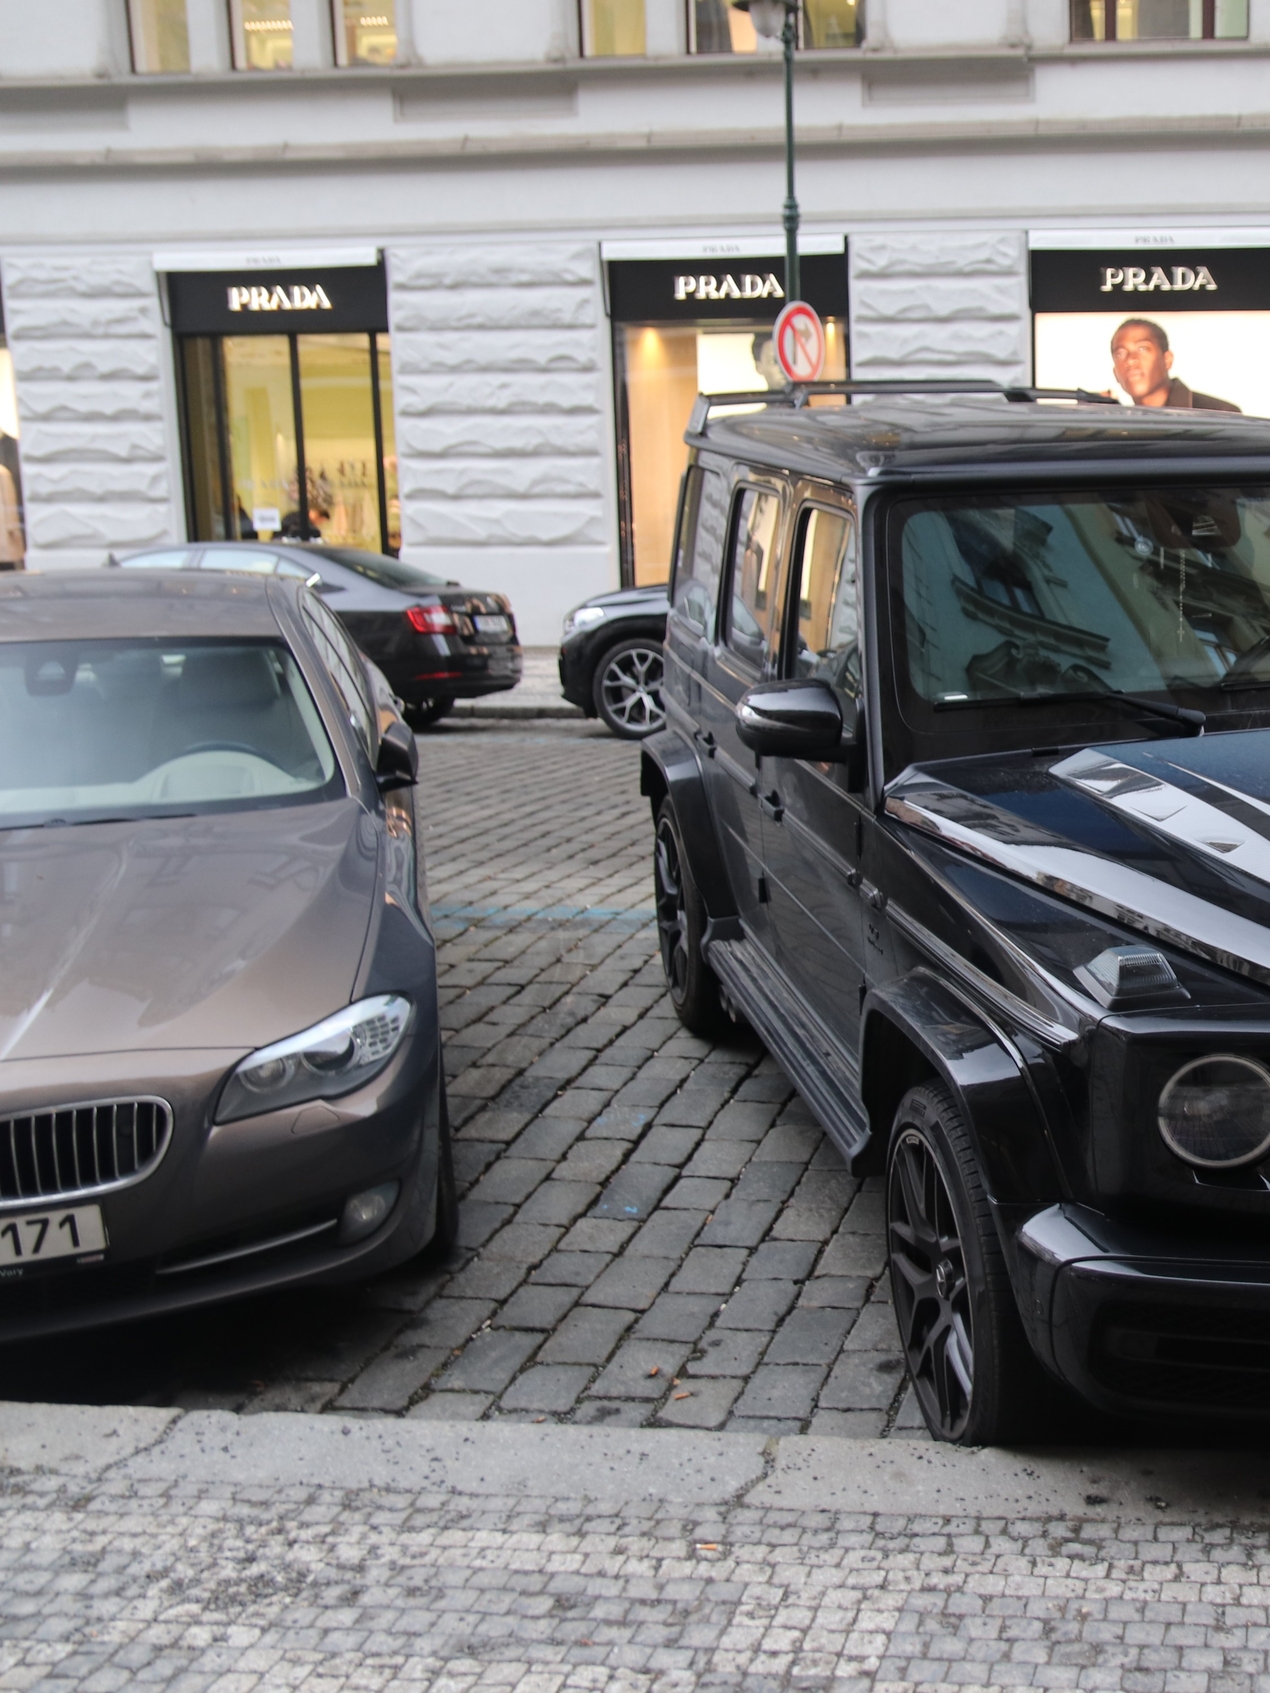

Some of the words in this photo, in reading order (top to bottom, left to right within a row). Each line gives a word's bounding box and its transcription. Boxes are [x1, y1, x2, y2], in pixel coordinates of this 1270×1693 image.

[673, 273, 785, 300] PRADA
[1099, 266, 1219, 292] PRADA
[227, 283, 333, 312] PRADA
